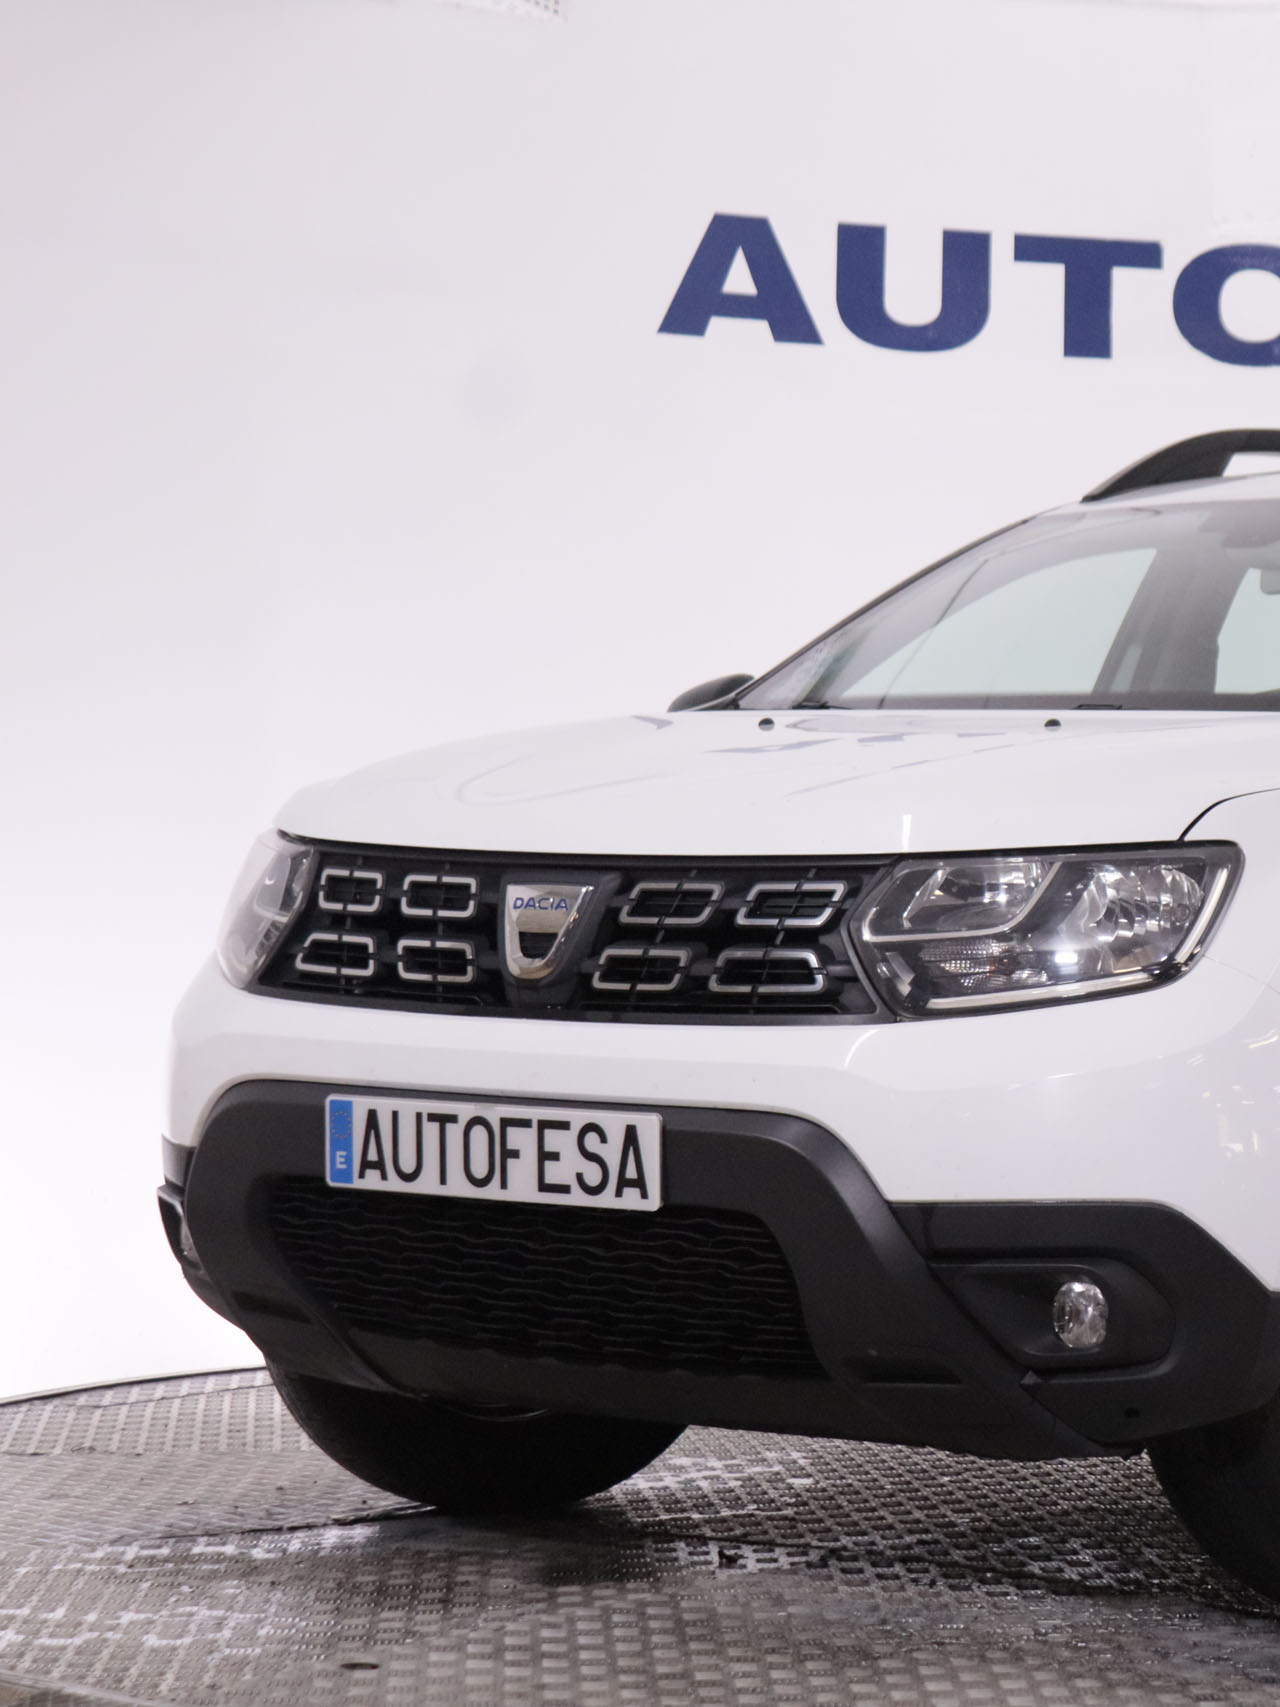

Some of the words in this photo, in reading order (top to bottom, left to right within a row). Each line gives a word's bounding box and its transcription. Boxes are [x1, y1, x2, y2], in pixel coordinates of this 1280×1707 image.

[512, 896, 568, 912] DACIA
[335, 1150, 347, 1169] E
[358, 1108, 649, 1200] AUTOFESA
